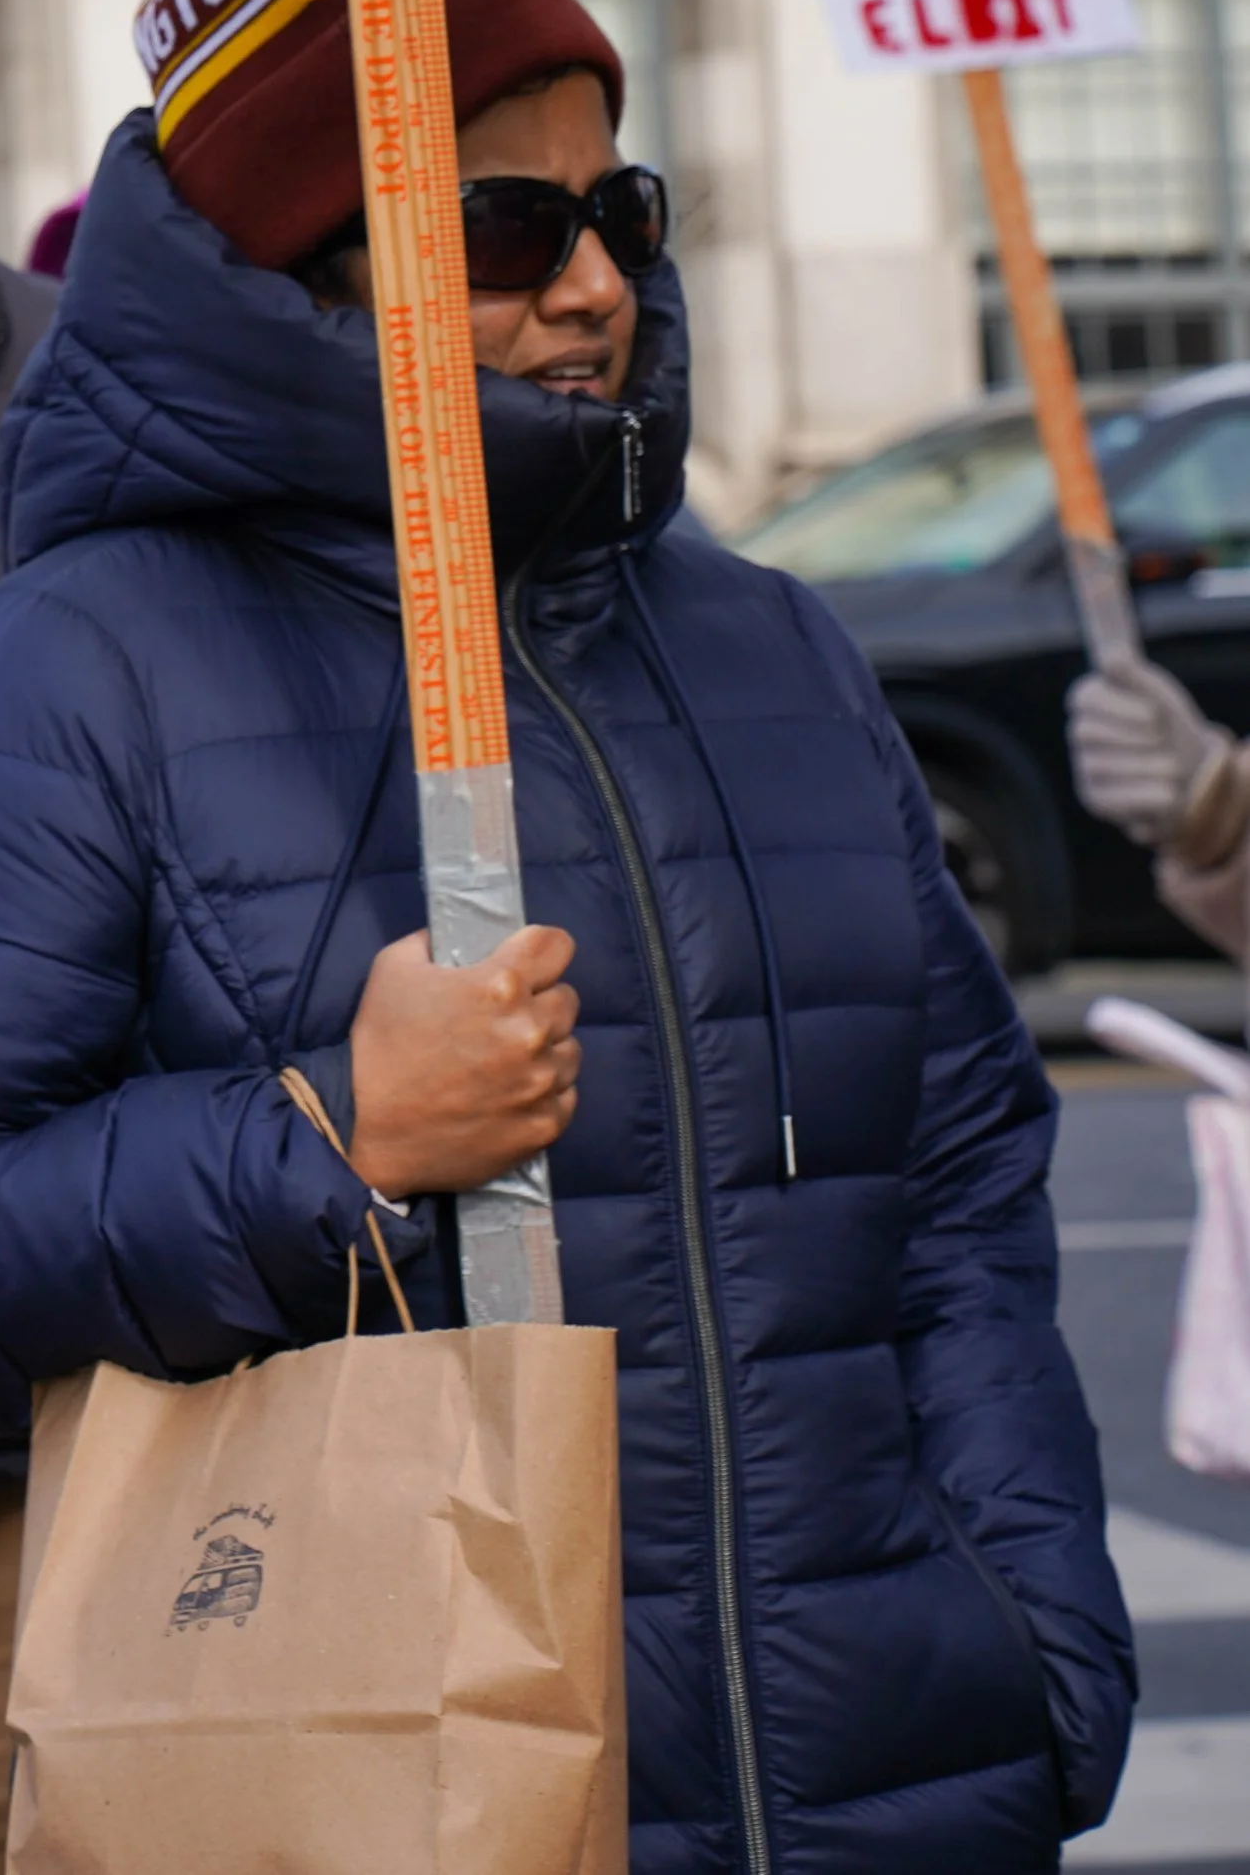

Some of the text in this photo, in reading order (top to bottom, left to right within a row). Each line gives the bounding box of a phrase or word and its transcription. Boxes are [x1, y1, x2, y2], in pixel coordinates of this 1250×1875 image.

[363, 54, 410, 205] DEPOT
[386, 305, 422, 416] HOME
[397, 425, 426, 475] OF
[403, 483, 433, 559] THE
[410, 568, 449, 697] FINEST
